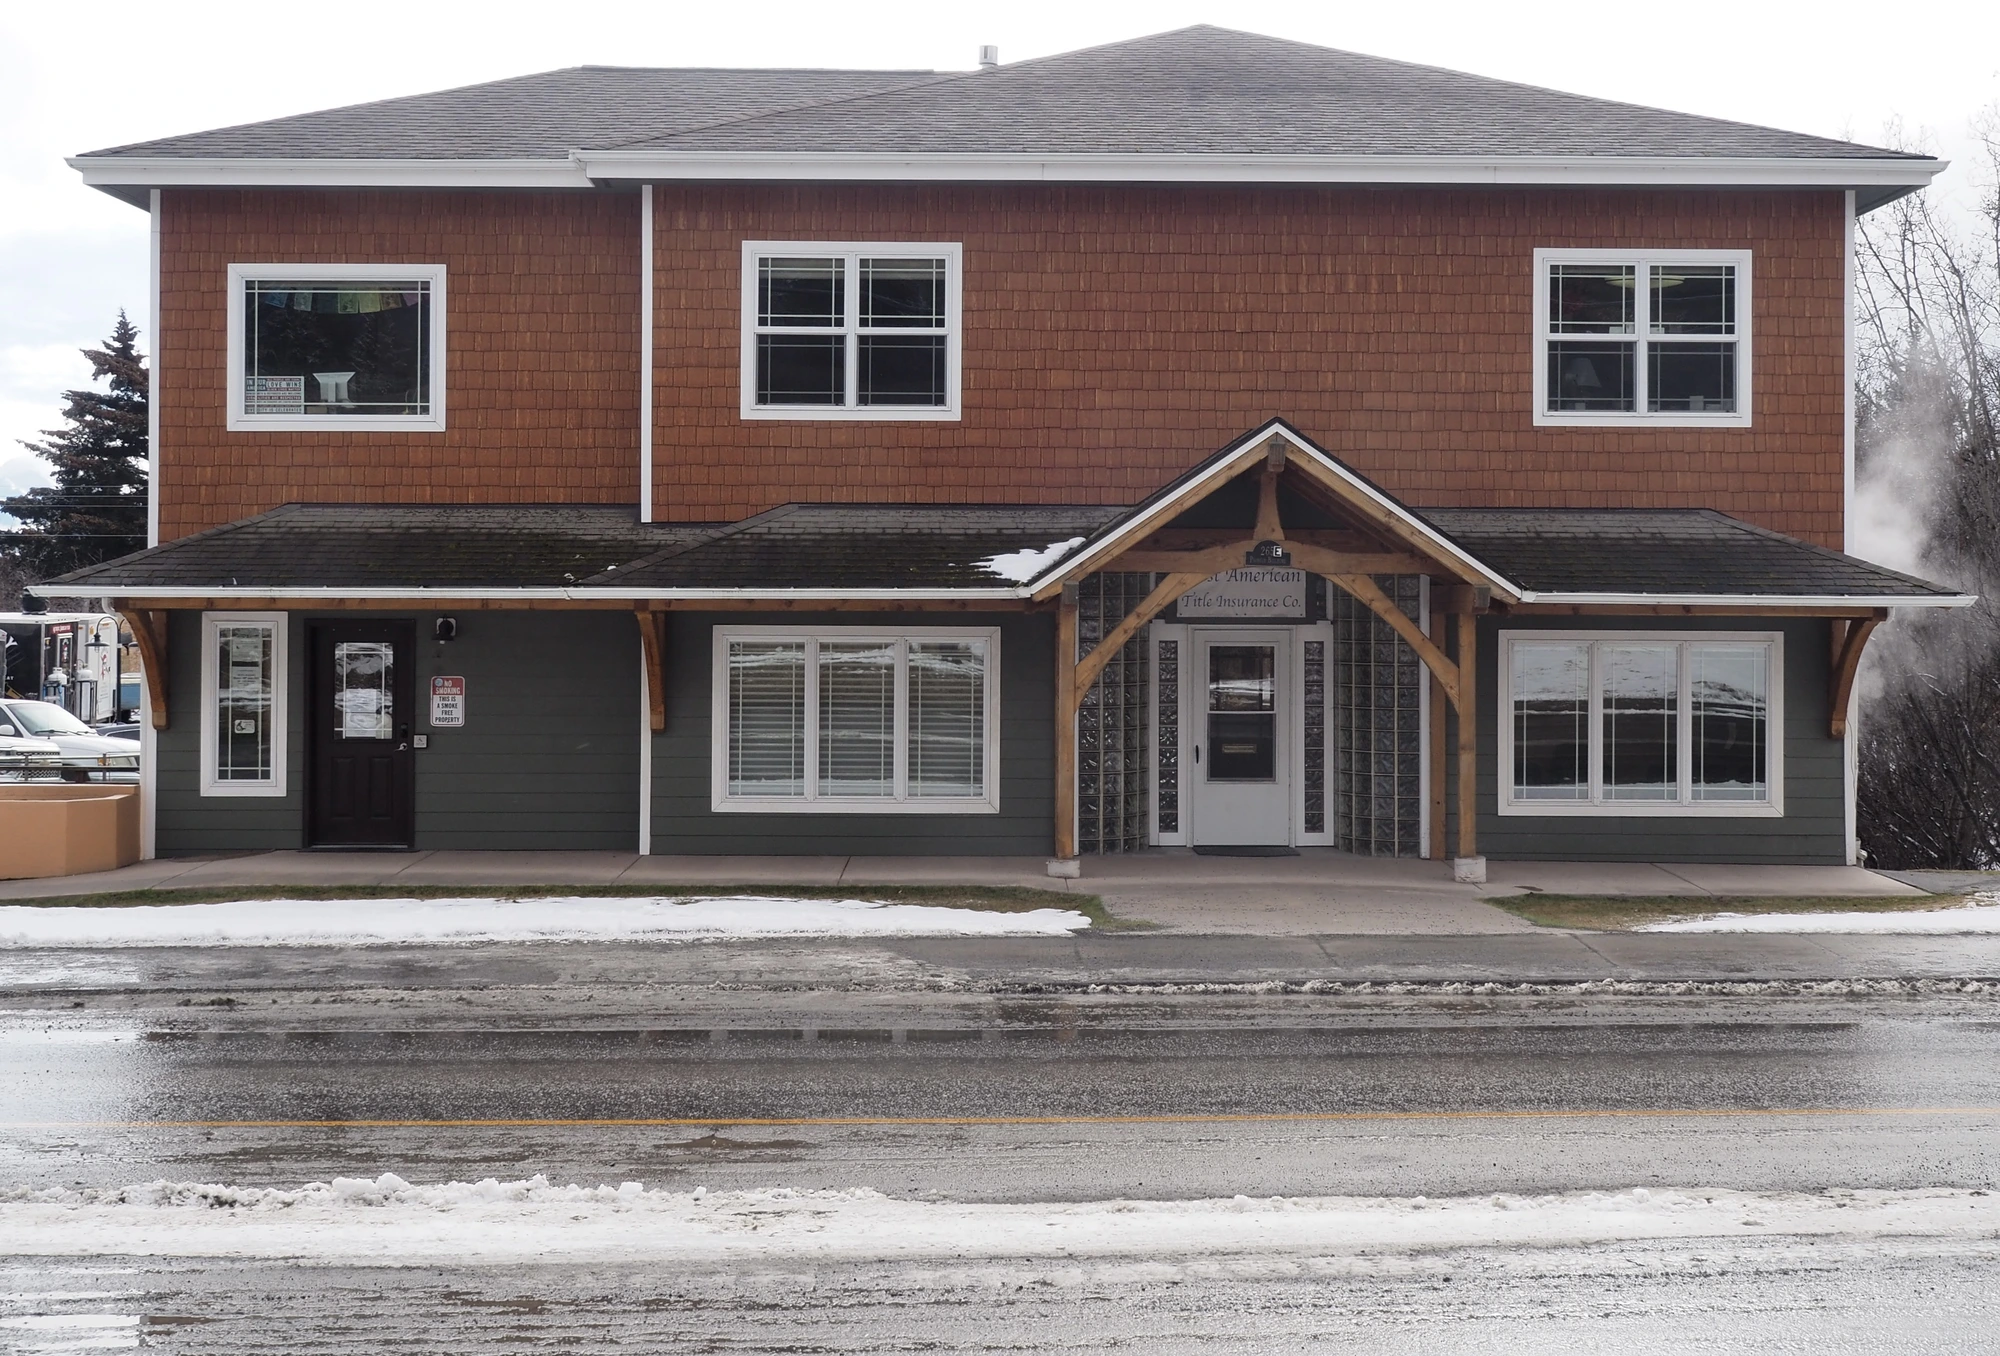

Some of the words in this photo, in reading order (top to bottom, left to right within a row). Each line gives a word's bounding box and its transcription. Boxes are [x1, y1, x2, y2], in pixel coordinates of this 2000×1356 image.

[1225, 567, 1301, 582] American
[1181, 592, 1212, 607] Title
[1216, 595, 1278, 607] Insurance
[1282, 595, 1301, 607] Co.
